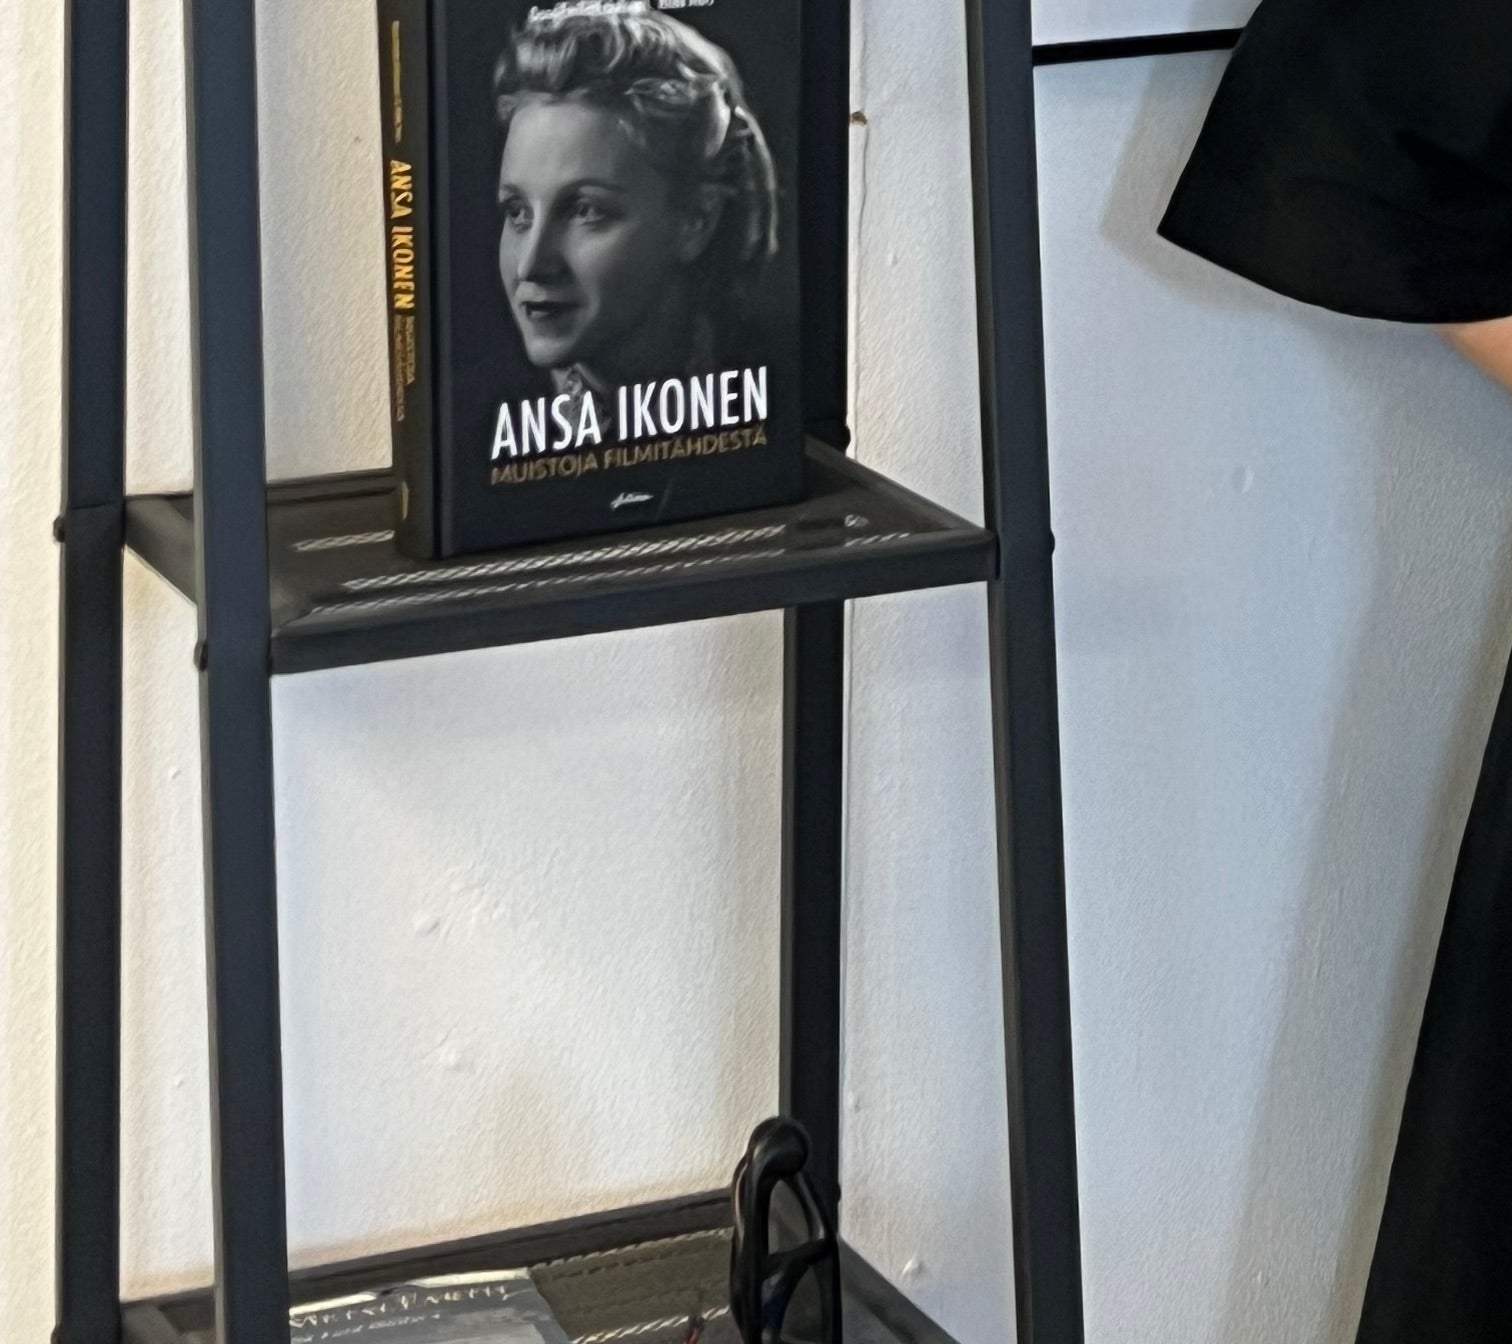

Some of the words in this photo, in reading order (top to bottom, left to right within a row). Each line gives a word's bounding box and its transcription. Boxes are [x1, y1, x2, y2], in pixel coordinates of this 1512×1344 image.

[390, 159, 413, 219] ANSA
[391, 225, 415, 310] IKONEN
[490, 389, 602, 461] ANSA
[617, 365, 768, 441] IKONEN
[490, 454, 599, 486] MUISTOJA
